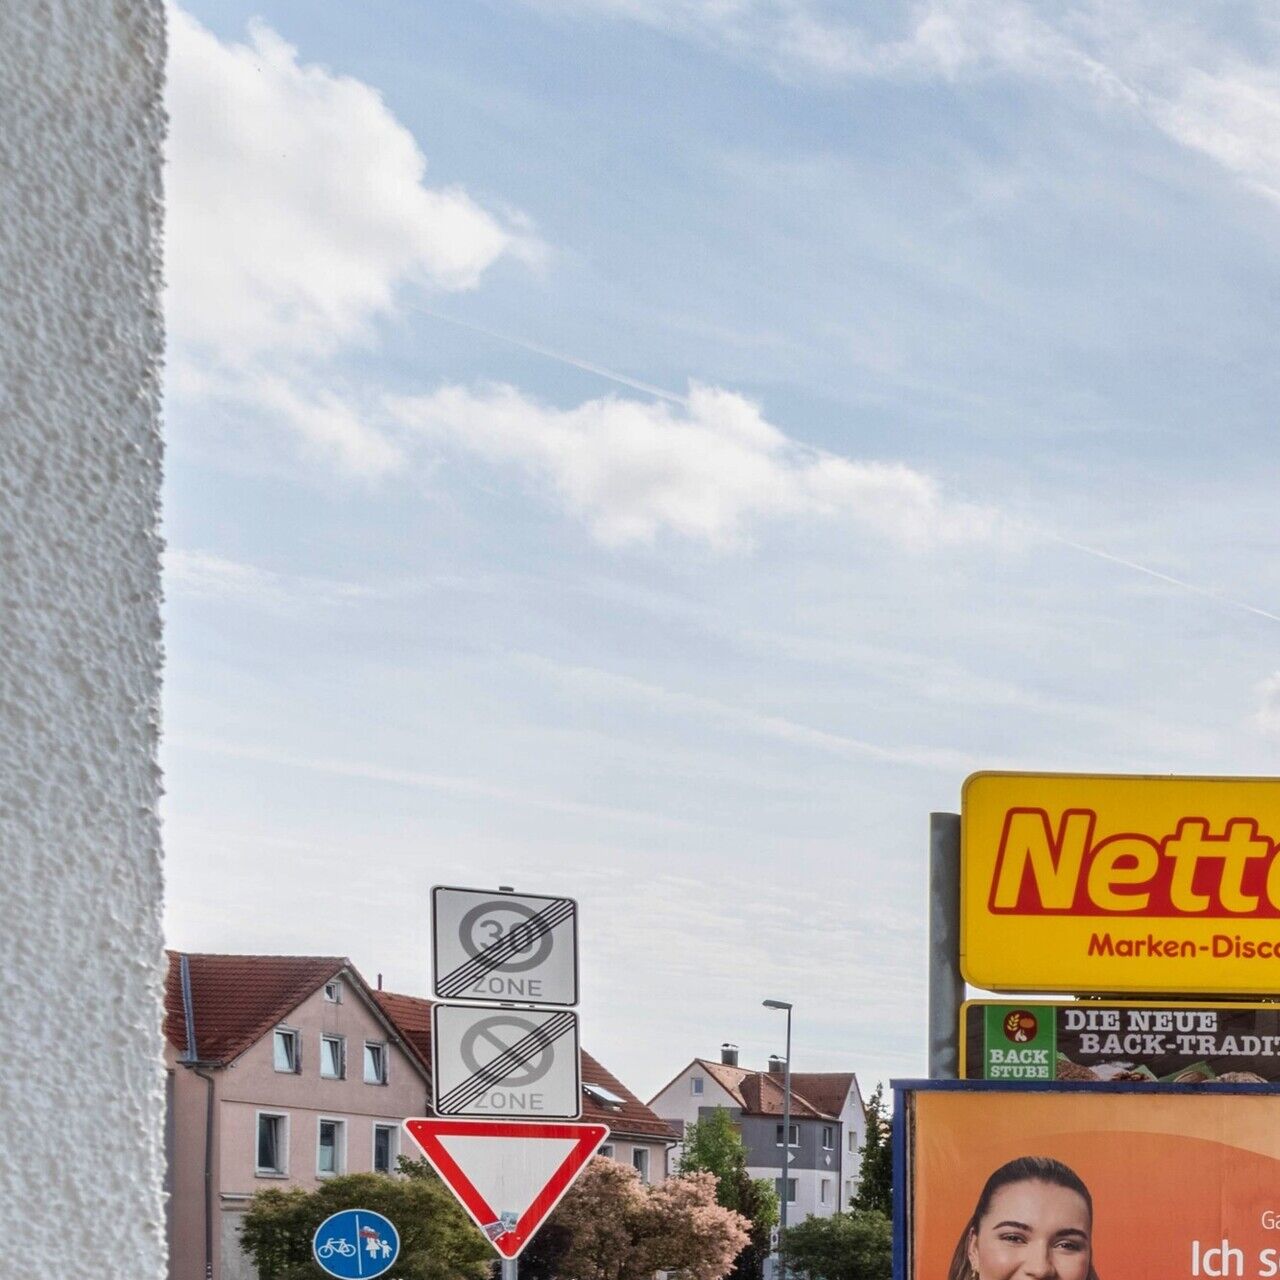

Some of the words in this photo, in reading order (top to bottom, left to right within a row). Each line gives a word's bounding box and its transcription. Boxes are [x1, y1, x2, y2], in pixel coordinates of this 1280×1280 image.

[479, 919, 533, 954] 30
[472, 976, 543, 997] ZONE
[1064, 1009, 1121, 1031] DIE
[1127, 1010, 1218, 1032] NEUE
[989, 1048, 1049, 1065] BACK
[990, 1065, 1049, 1079] STUBE
[473, 1092, 544, 1111] ZONE
[1190, 1239, 1244, 1277] Ich
